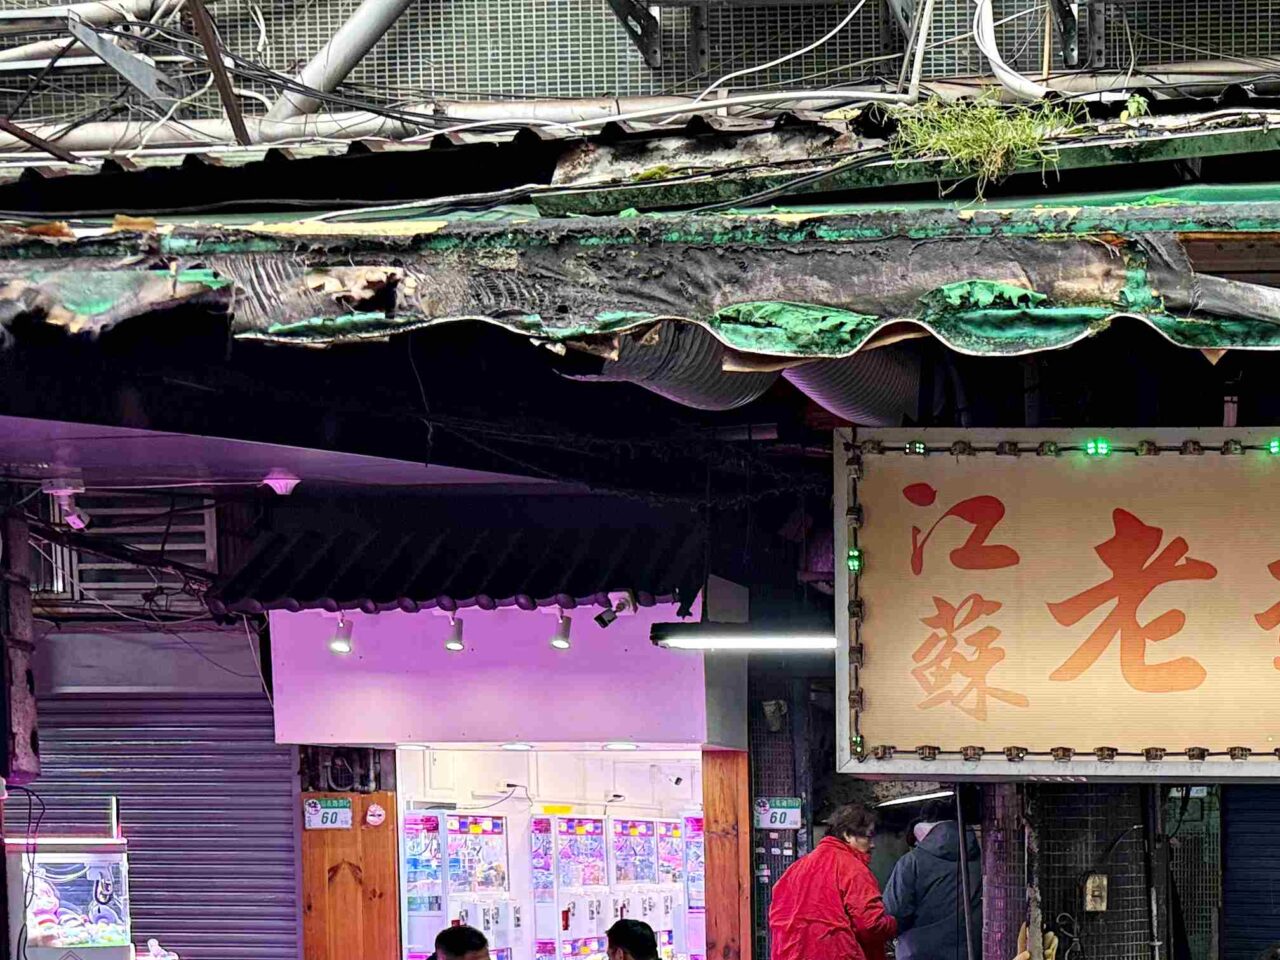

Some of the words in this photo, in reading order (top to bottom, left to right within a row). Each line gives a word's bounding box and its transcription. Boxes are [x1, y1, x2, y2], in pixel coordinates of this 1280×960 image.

[902, 482, 1030, 721] 江蘇
[321, 811, 338, 825] 60
[769, 811, 787, 824] 60
